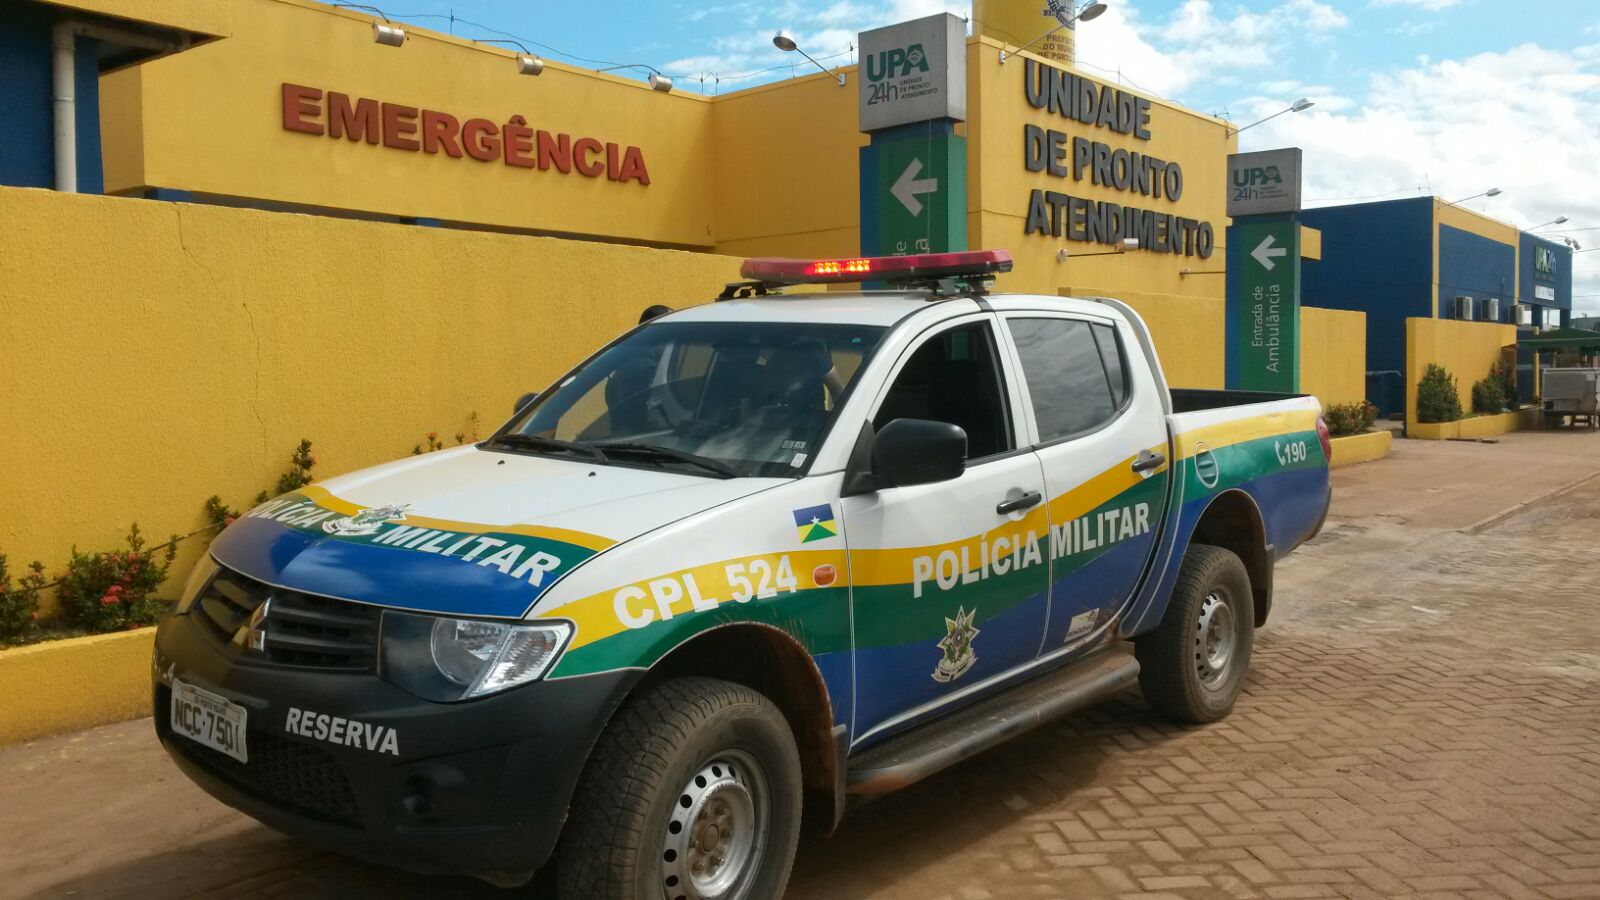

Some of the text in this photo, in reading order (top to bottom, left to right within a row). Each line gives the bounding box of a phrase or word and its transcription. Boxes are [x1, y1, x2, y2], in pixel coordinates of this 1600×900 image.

[867, 43, 929, 82] UPA
[867, 82, 898, 105] 24h
[1025, 57, 1151, 140] UNIDADE
[282, 83, 650, 186] EMERGÊNCIA
[1024, 124, 1183, 202] DE PRONTO
[1233, 166, 1282, 187] UPA
[1233, 187, 1258, 201] 24h
[1025, 189, 1214, 259] ATENDIMENTO
[1252, 286, 1263, 347] Entrada de
[1265, 284, 1280, 373] Ambulância
[1285, 440, 1307, 464] 190
[371, 524, 562, 588] MILITAR
[913, 502, 1150, 599] POLÍCIA MILITAR
[613, 554, 798, 630] CPL 524
[285, 707, 400, 756] RESERVA
